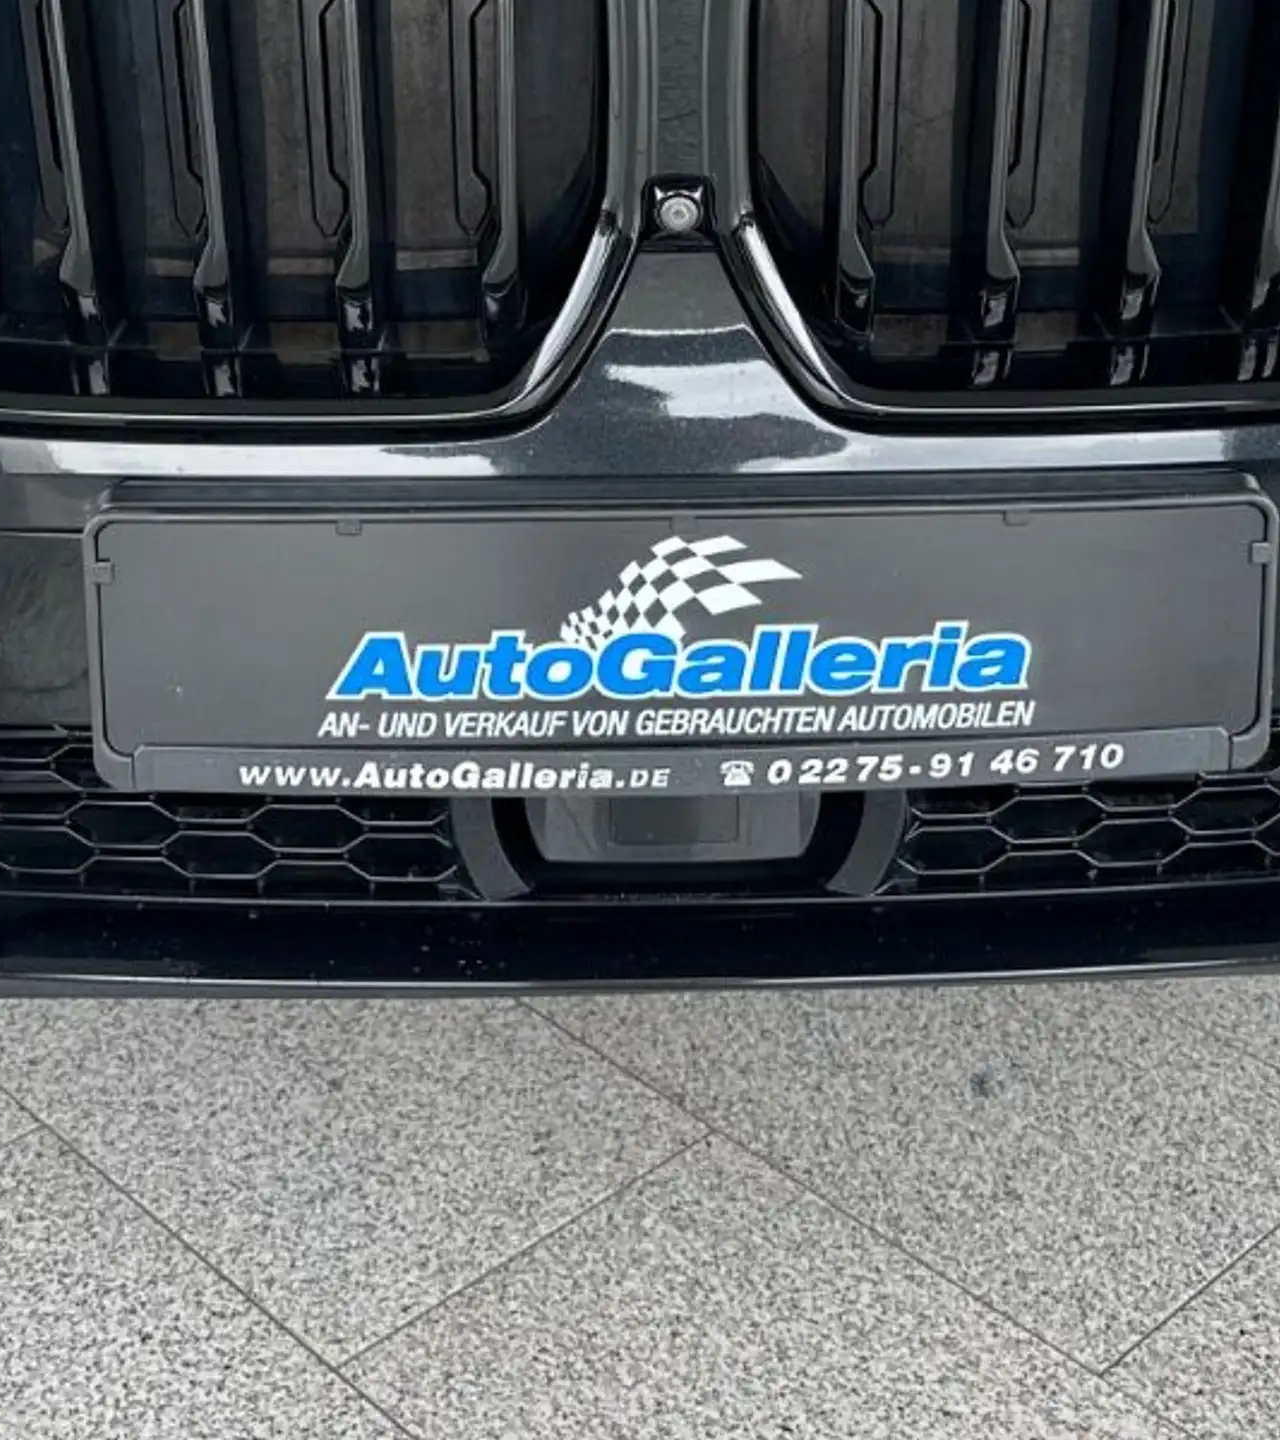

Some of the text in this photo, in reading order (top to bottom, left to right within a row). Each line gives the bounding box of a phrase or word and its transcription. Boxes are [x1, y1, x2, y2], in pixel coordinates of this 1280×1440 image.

[325, 620, 1032, 701] AutoGalleria
[318, 701, 1035, 738] AN- UND VERKAUF VON GEBRAUCHTEN AUTOMOBILEN
[239, 760, 670, 790] www.AutoGalleria.DE
[990, 748, 1038, 774] 46
[1053, 744, 1124, 771] 710
